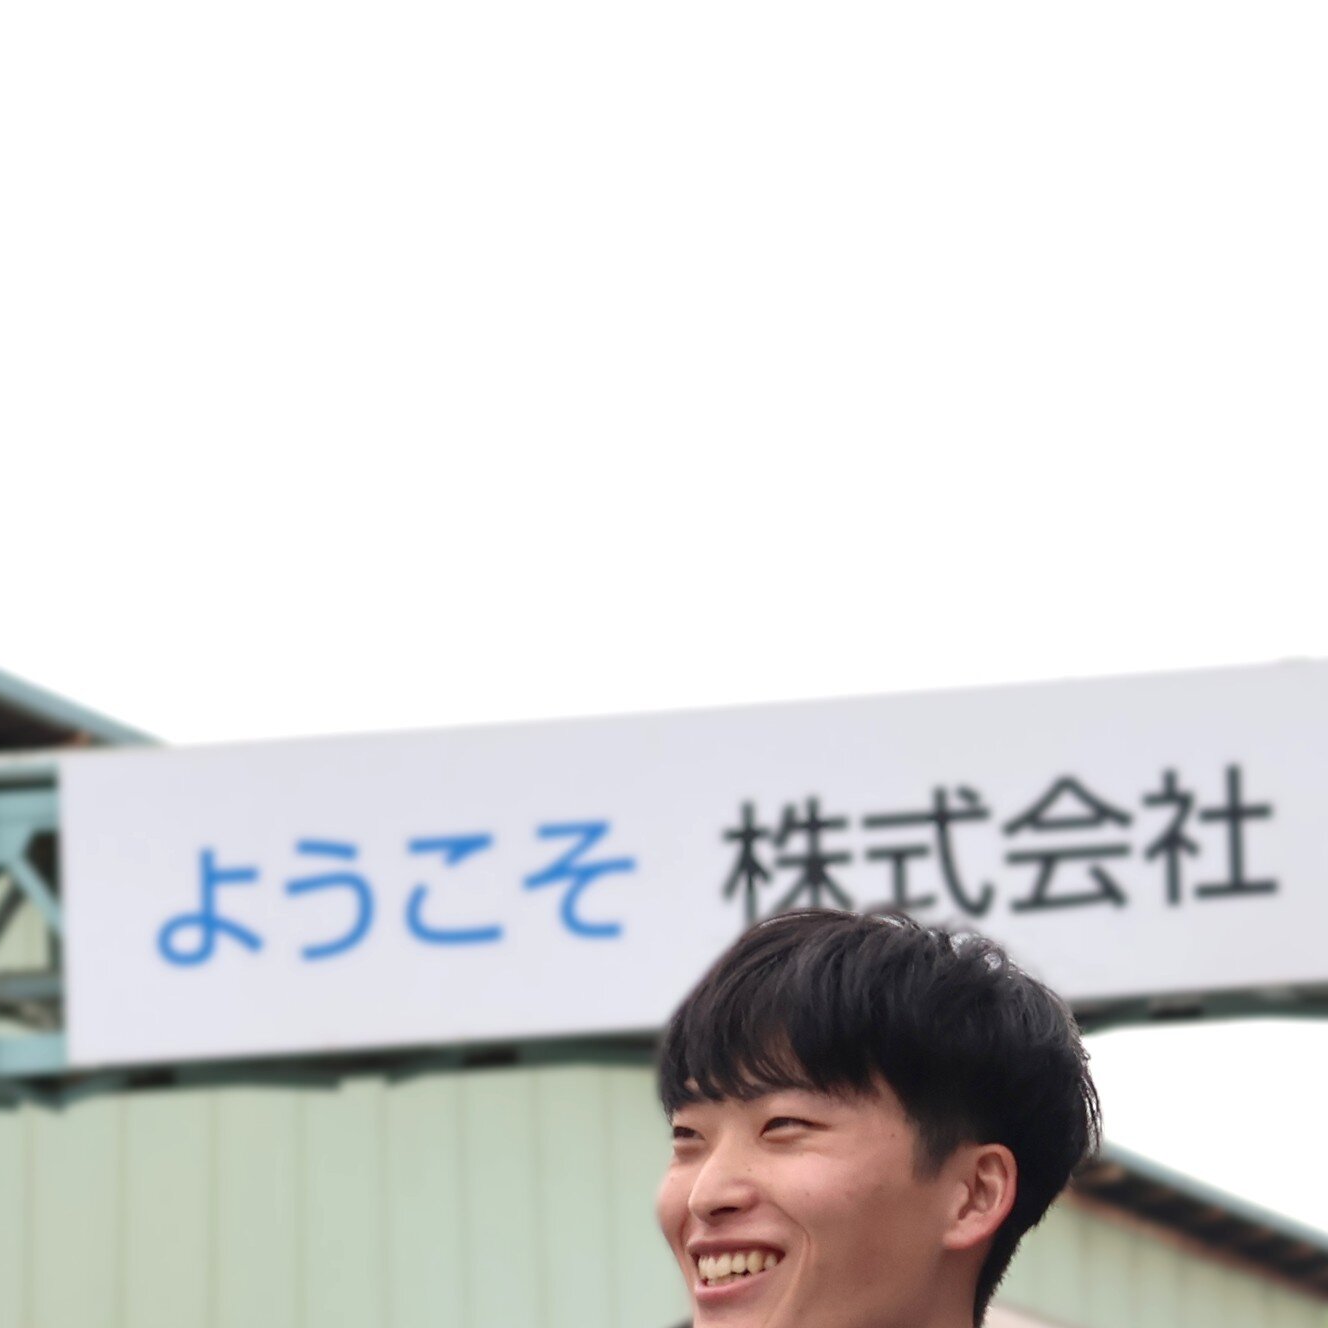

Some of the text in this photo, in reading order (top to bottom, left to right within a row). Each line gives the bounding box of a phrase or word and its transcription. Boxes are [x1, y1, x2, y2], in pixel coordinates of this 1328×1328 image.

[156, 819, 638, 969] ようこそ
[722, 764, 1279, 922] 株式会社
